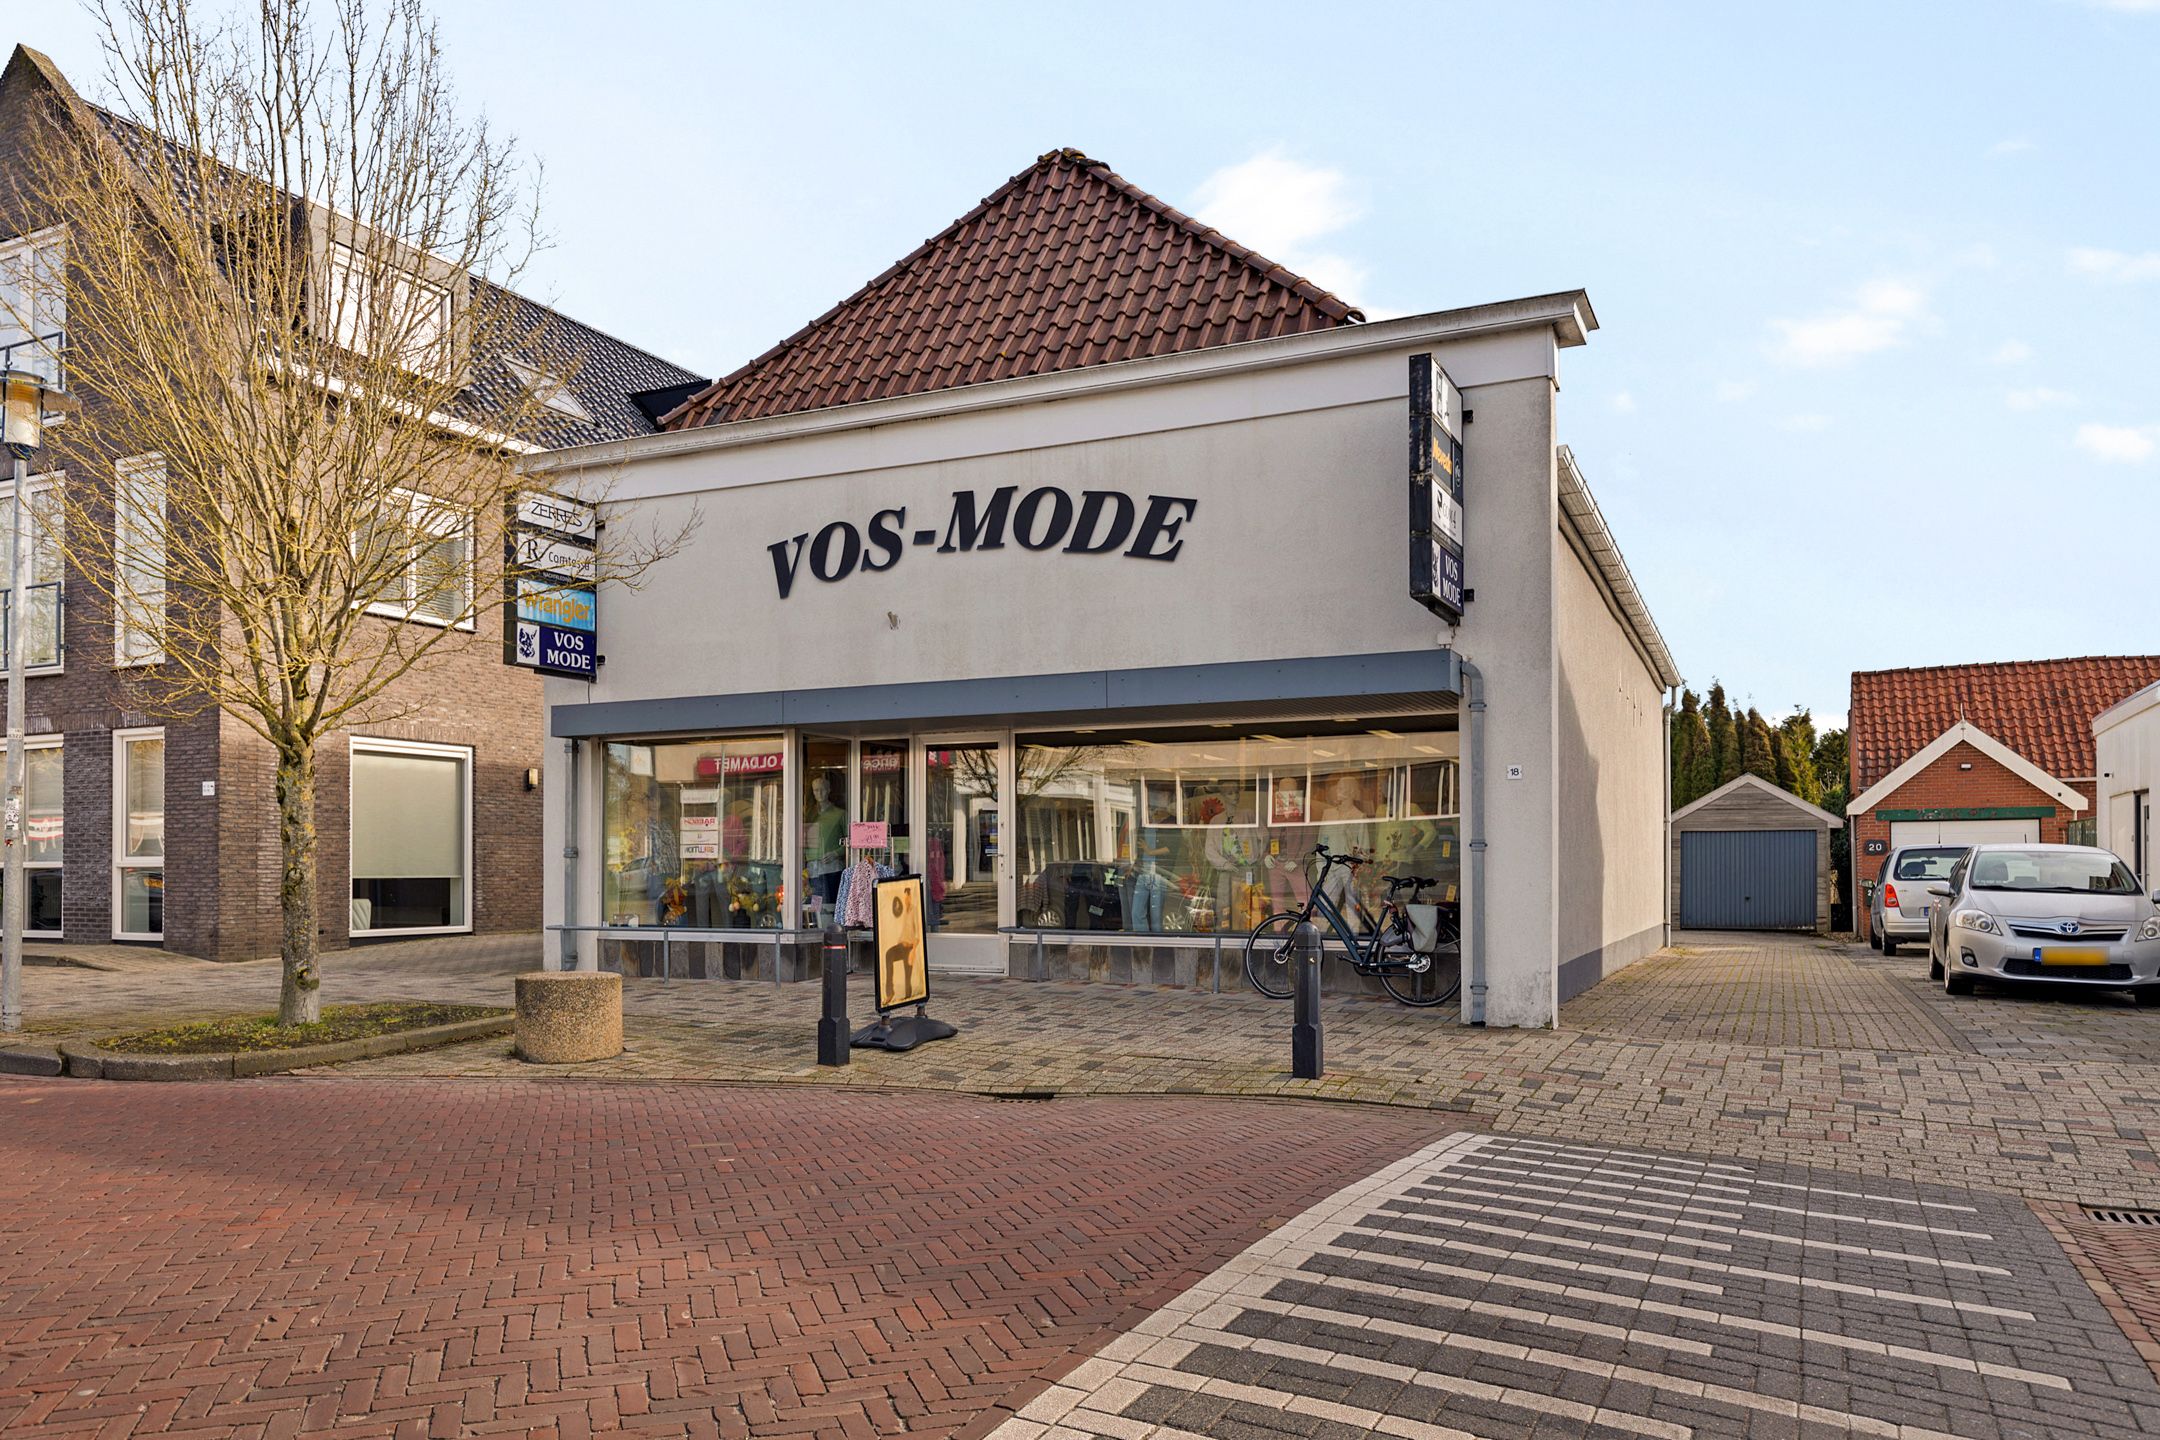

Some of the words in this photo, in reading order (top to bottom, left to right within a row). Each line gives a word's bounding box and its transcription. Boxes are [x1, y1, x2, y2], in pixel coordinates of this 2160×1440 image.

[531, 501, 582, 527] ZERRES
[767, 485, 1197, 599] VOS-MODE
[1445, 554, 1458, 581] VOS
[1442, 577, 1461, 607] MODE
[524, 588, 591, 623] Wrangler
[554, 631, 584, 651] VOS
[547, 648, 591, 670] MODE
[1510, 767, 1520, 776] 18
[1868, 843, 1882, 851] 20
